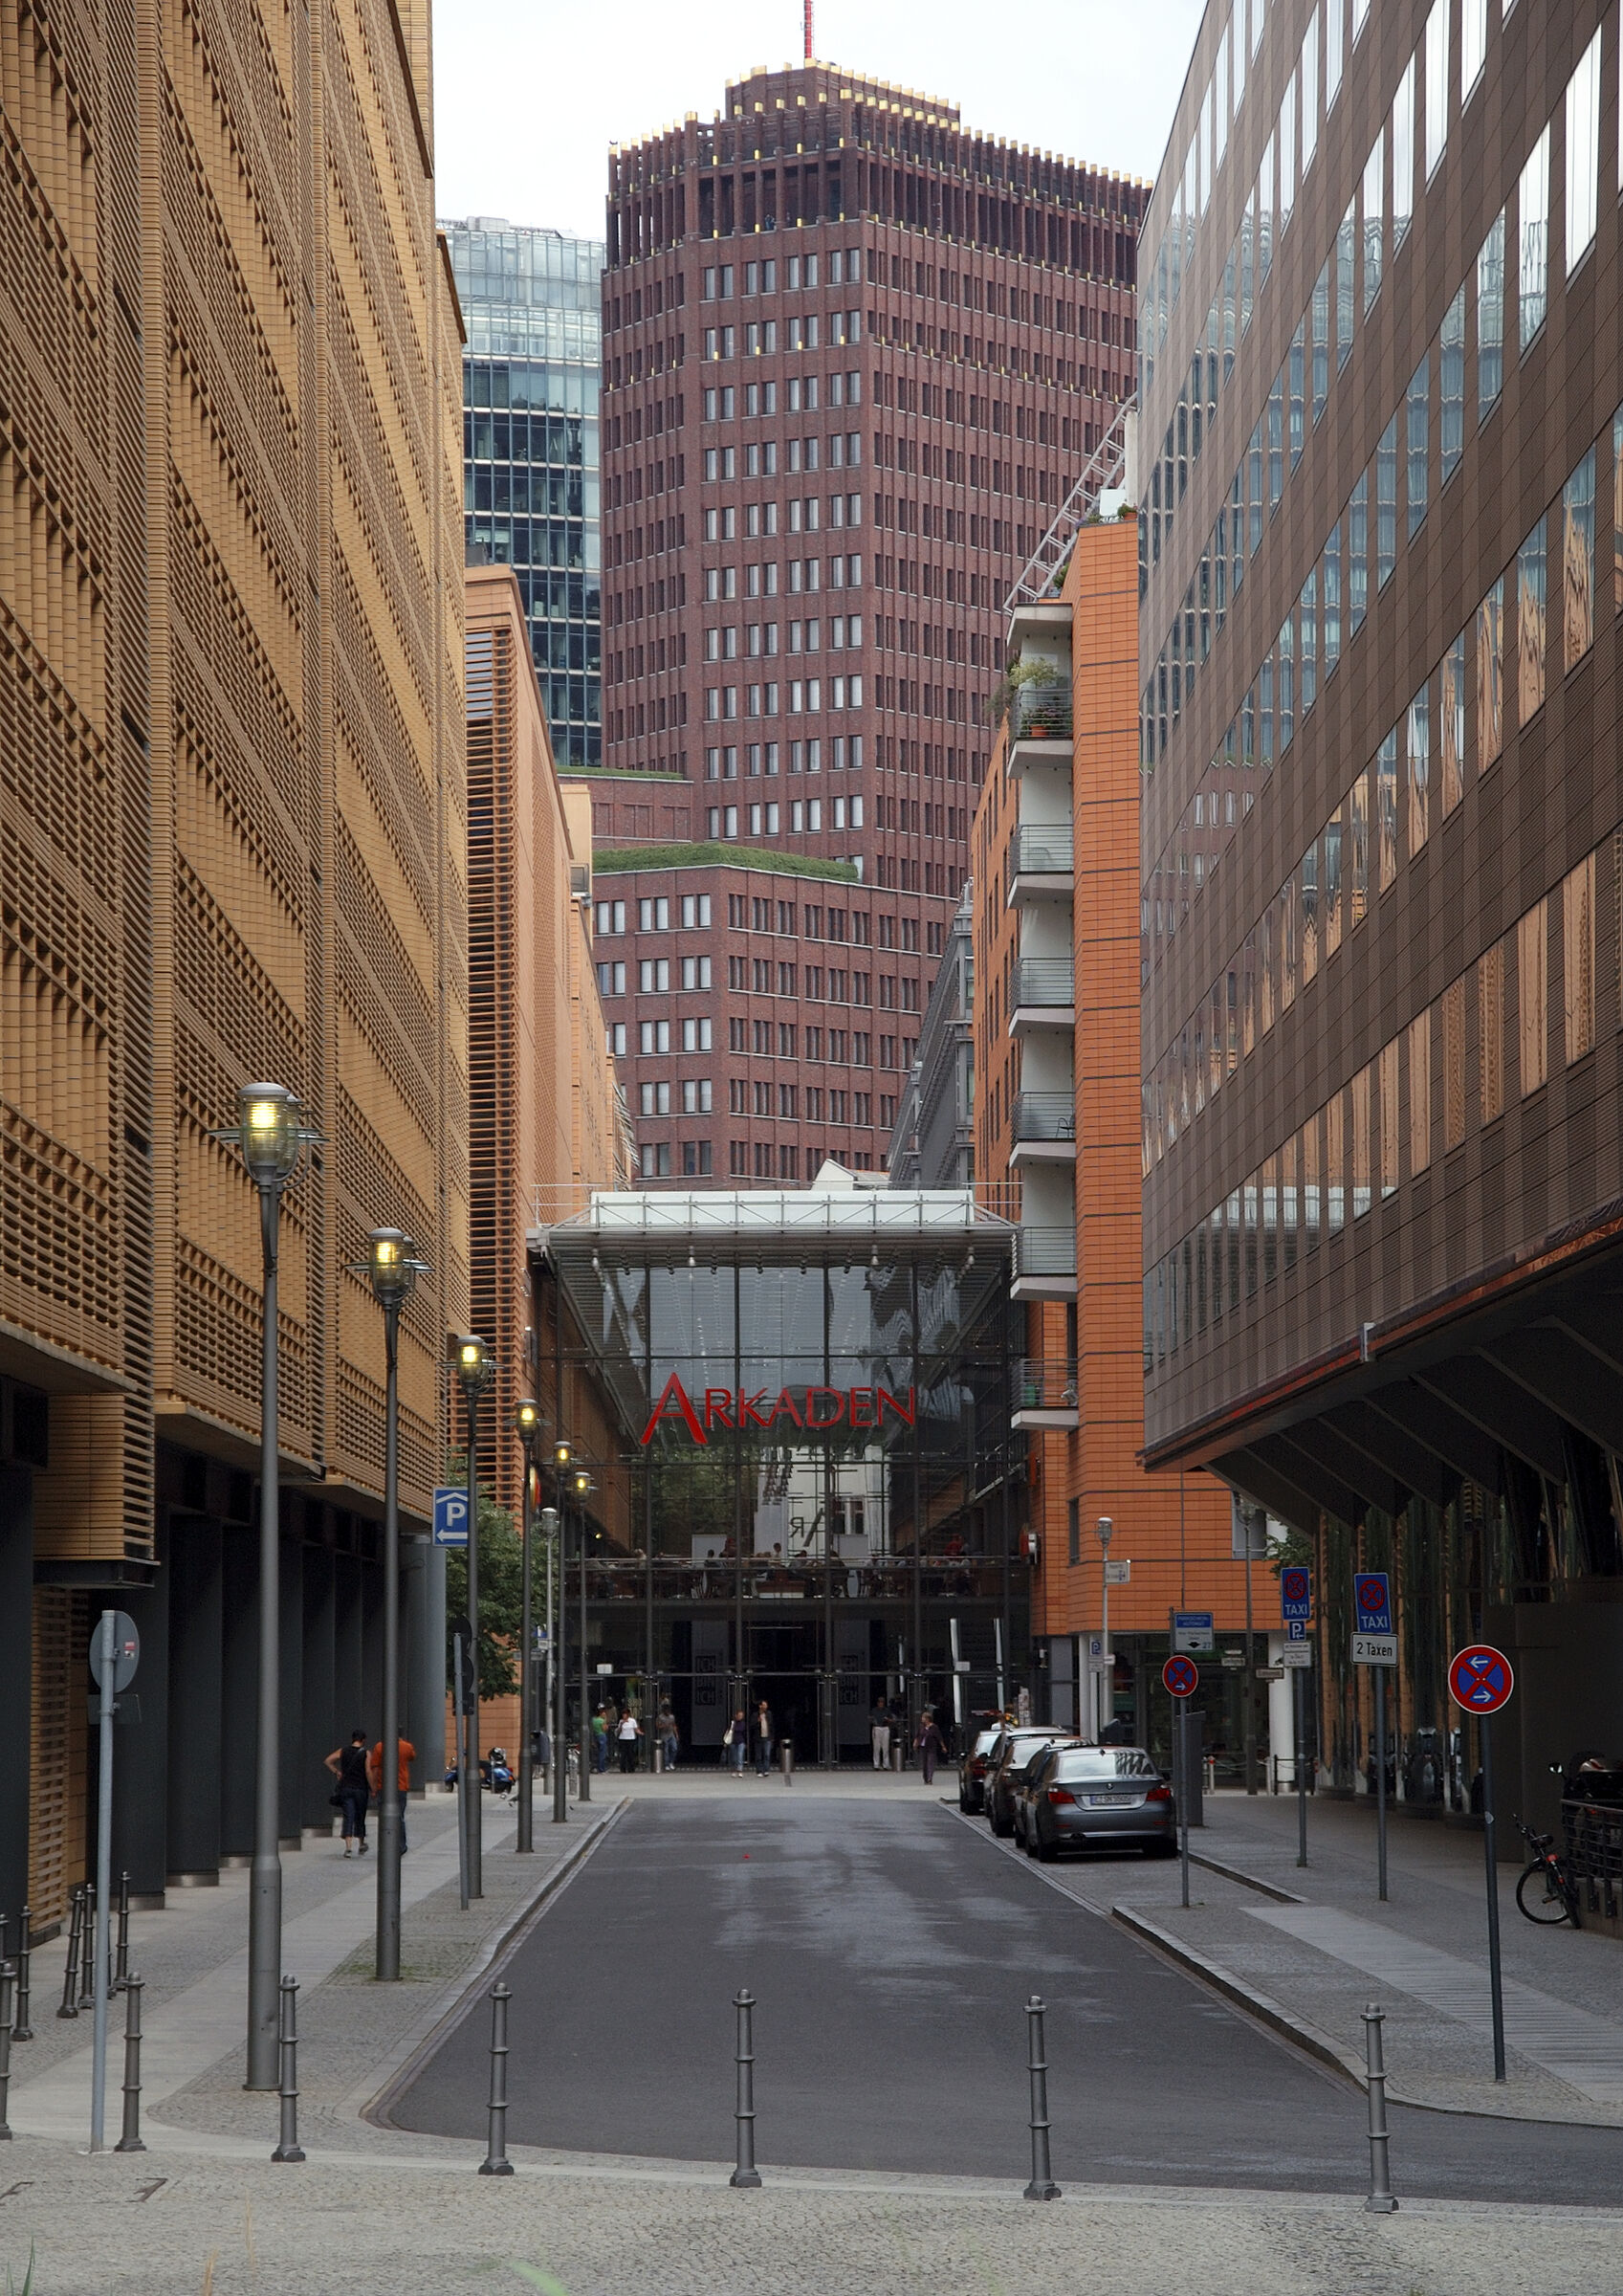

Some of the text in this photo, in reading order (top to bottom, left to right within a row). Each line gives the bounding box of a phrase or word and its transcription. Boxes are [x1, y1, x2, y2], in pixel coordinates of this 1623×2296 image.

[640, 1372, 915, 1445] ARKADEN
[447, 1503, 466, 1527] P
[1284, 1604, 1308, 1616] TAXI
[1361, 1616, 1388, 1629] TAXI
[1292, 1623, 1302, 1639] P
[1356, 1643, 1393, 1657] 2 Taxen
